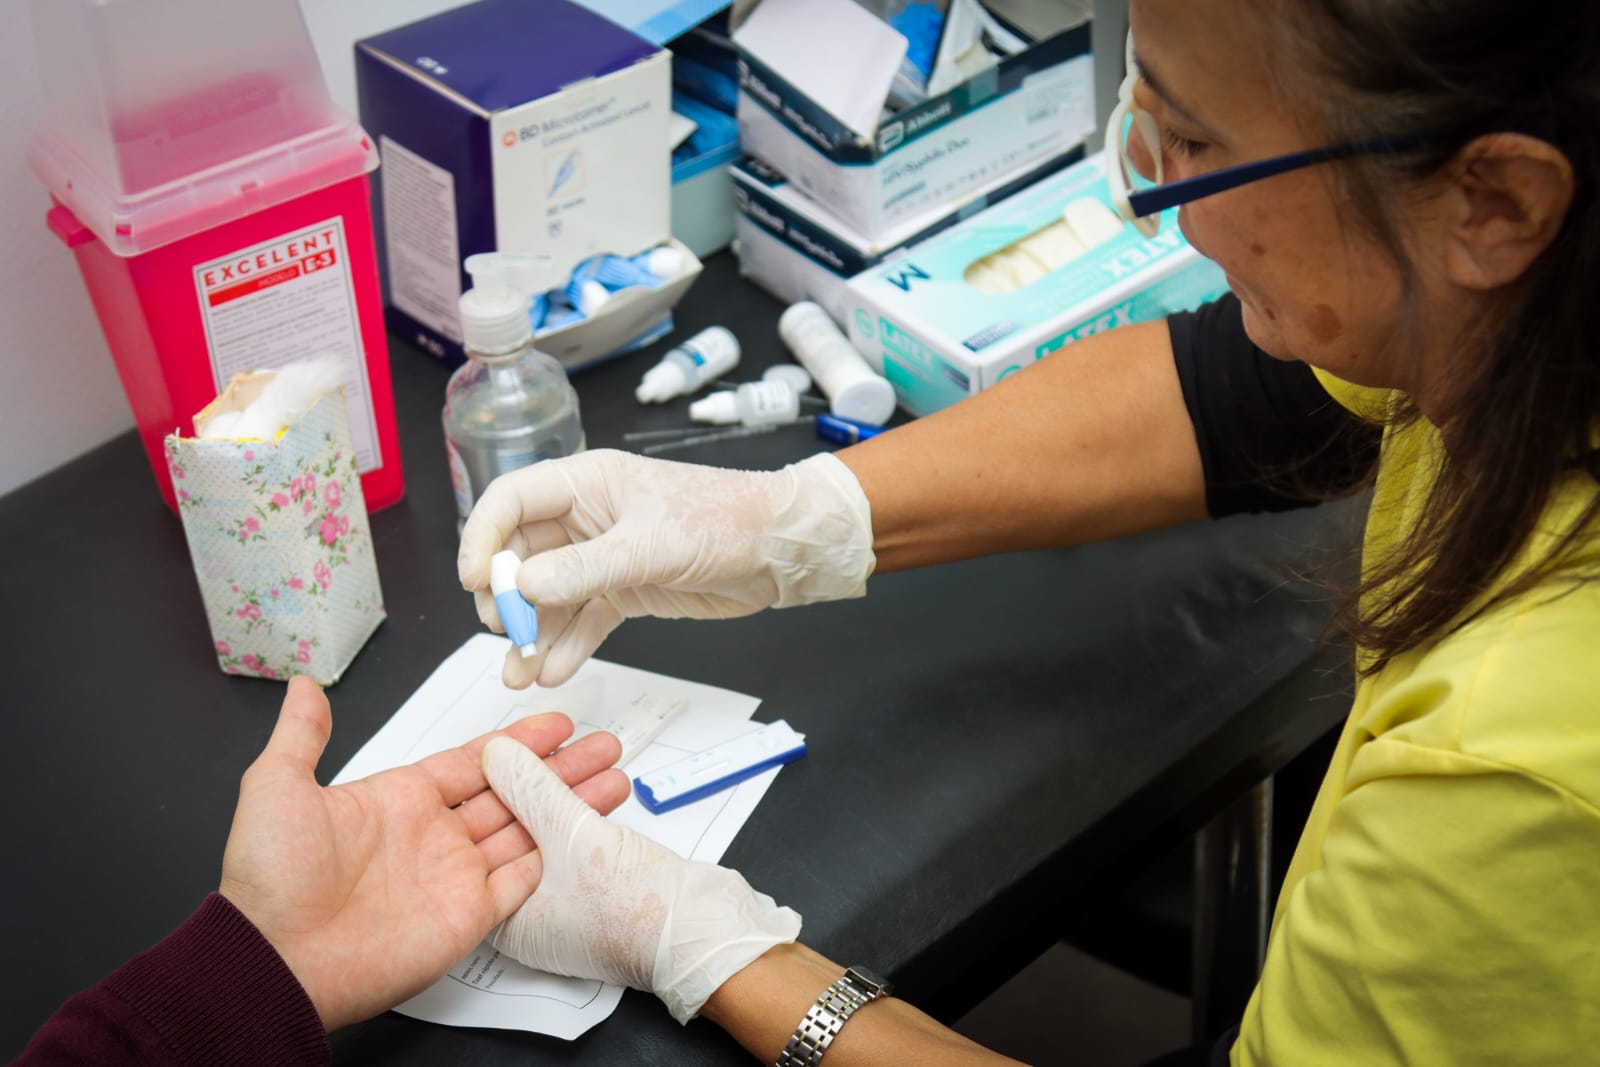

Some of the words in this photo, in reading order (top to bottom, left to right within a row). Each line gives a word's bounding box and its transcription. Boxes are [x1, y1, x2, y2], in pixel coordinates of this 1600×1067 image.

[520, 124, 539, 141] BD
[906, 101, 951, 134] Abbott
[204, 230, 334, 287] EXCELENT
[1101, 226, 1180, 278] ATEX
[886, 263, 931, 292] M
